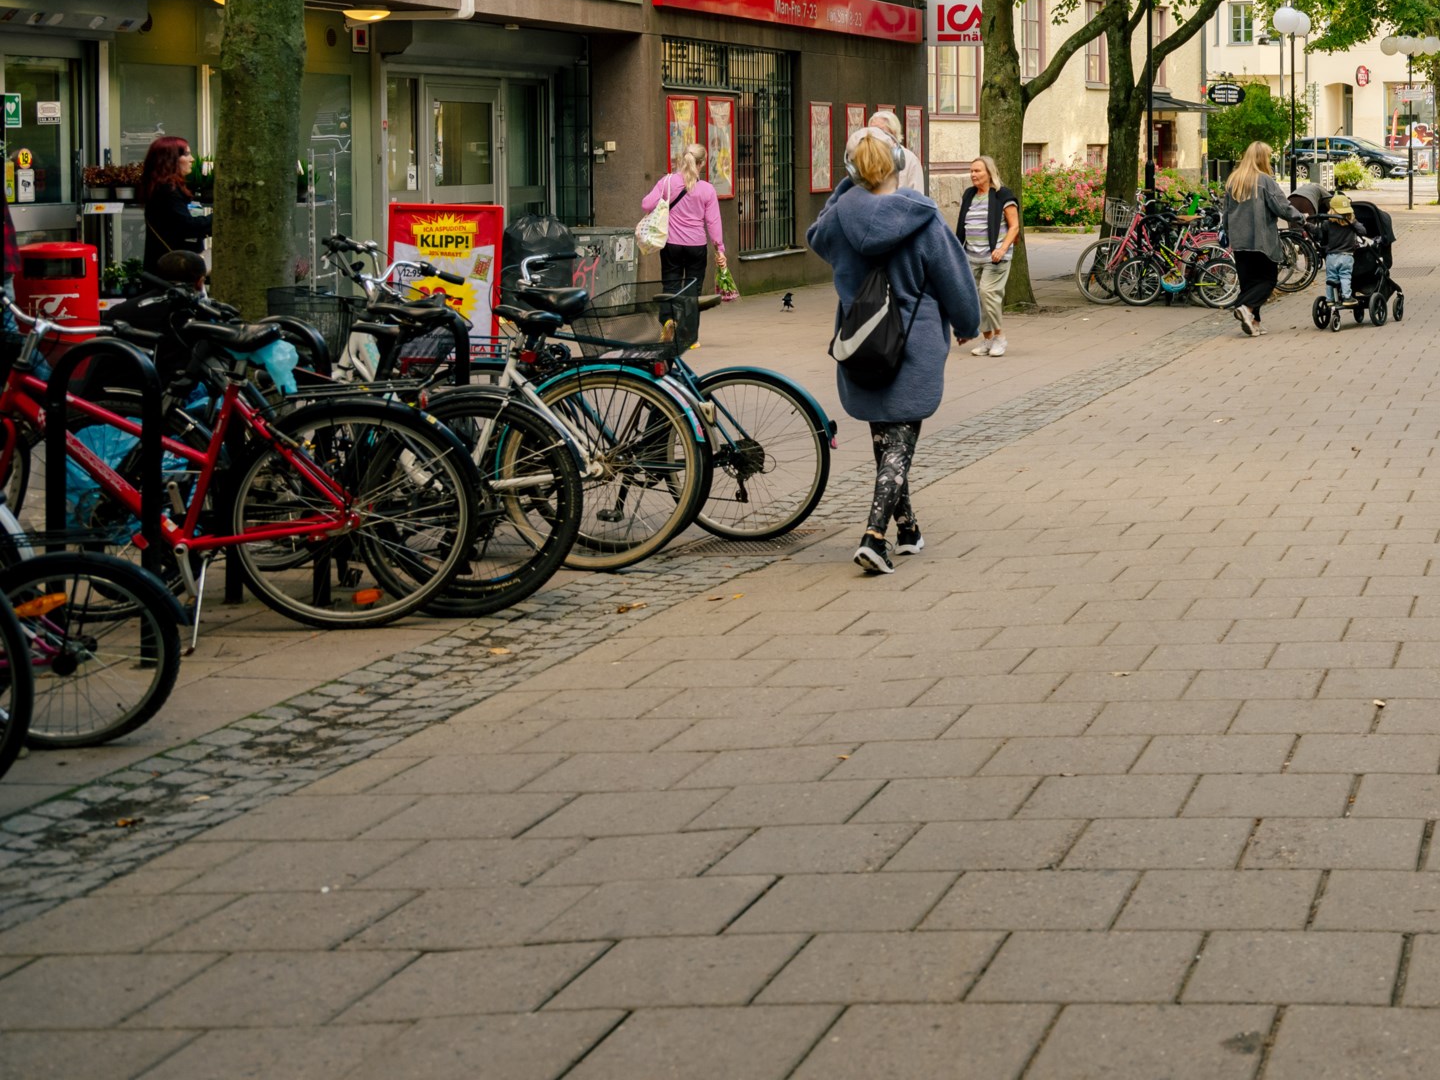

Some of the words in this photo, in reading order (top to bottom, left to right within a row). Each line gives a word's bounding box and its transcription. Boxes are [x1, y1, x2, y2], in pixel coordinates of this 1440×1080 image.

[937, 3, 982, 32] ICA
[962, 31, 983, 42] när
[423, 225, 434, 233] ICA
[435, 225, 467, 233] ASPUDDEN
[420, 234, 469, 249] KLIPP!
